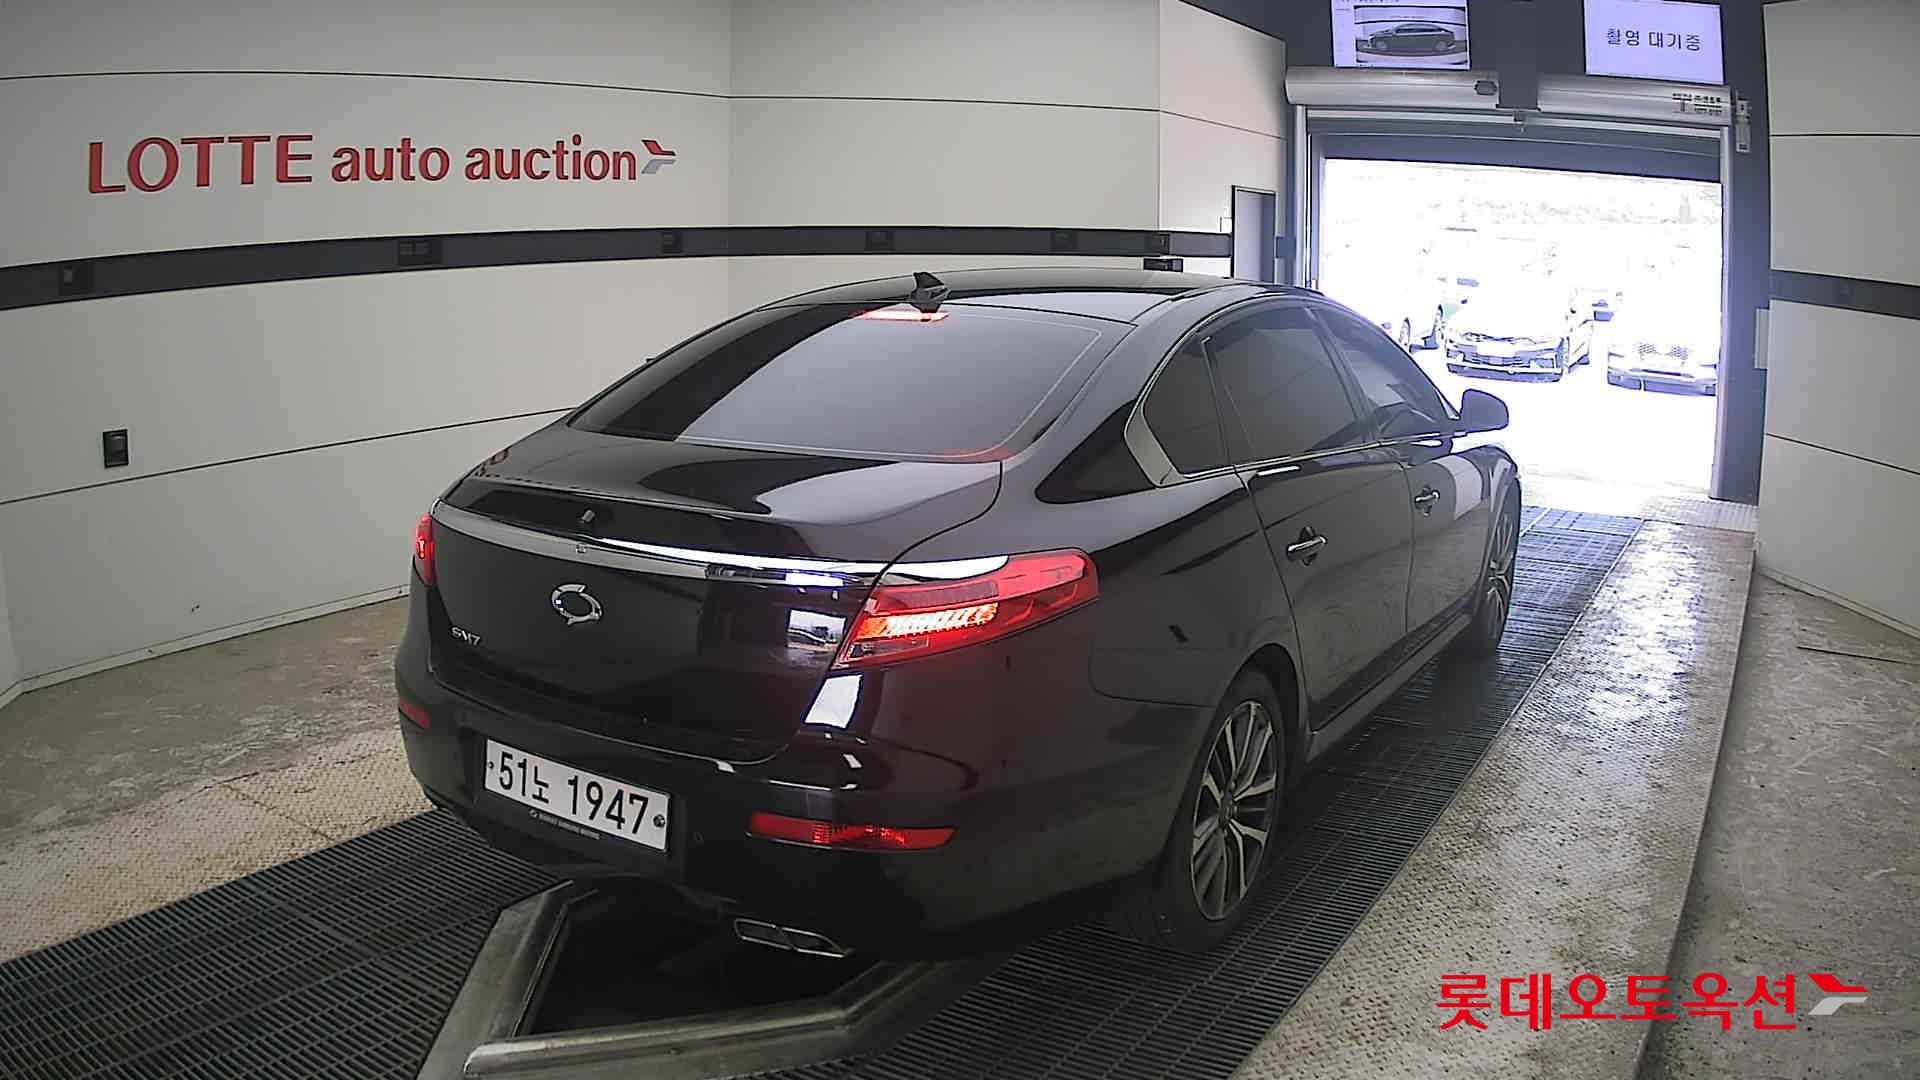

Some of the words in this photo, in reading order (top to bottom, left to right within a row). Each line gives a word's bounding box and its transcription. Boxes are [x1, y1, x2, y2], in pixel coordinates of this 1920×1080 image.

[1607, 28, 1640, 47] 촬영
[1648, 31, 1700, 52] 대기중
[88, 134, 313, 194] LOTTE
[330, 137, 450, 182] auto
[464, 134, 638, 181] auction
[451, 626, 481, 646] SM7
[498, 750, 550, 805] 51노
[566, 774, 650, 835] 1947
